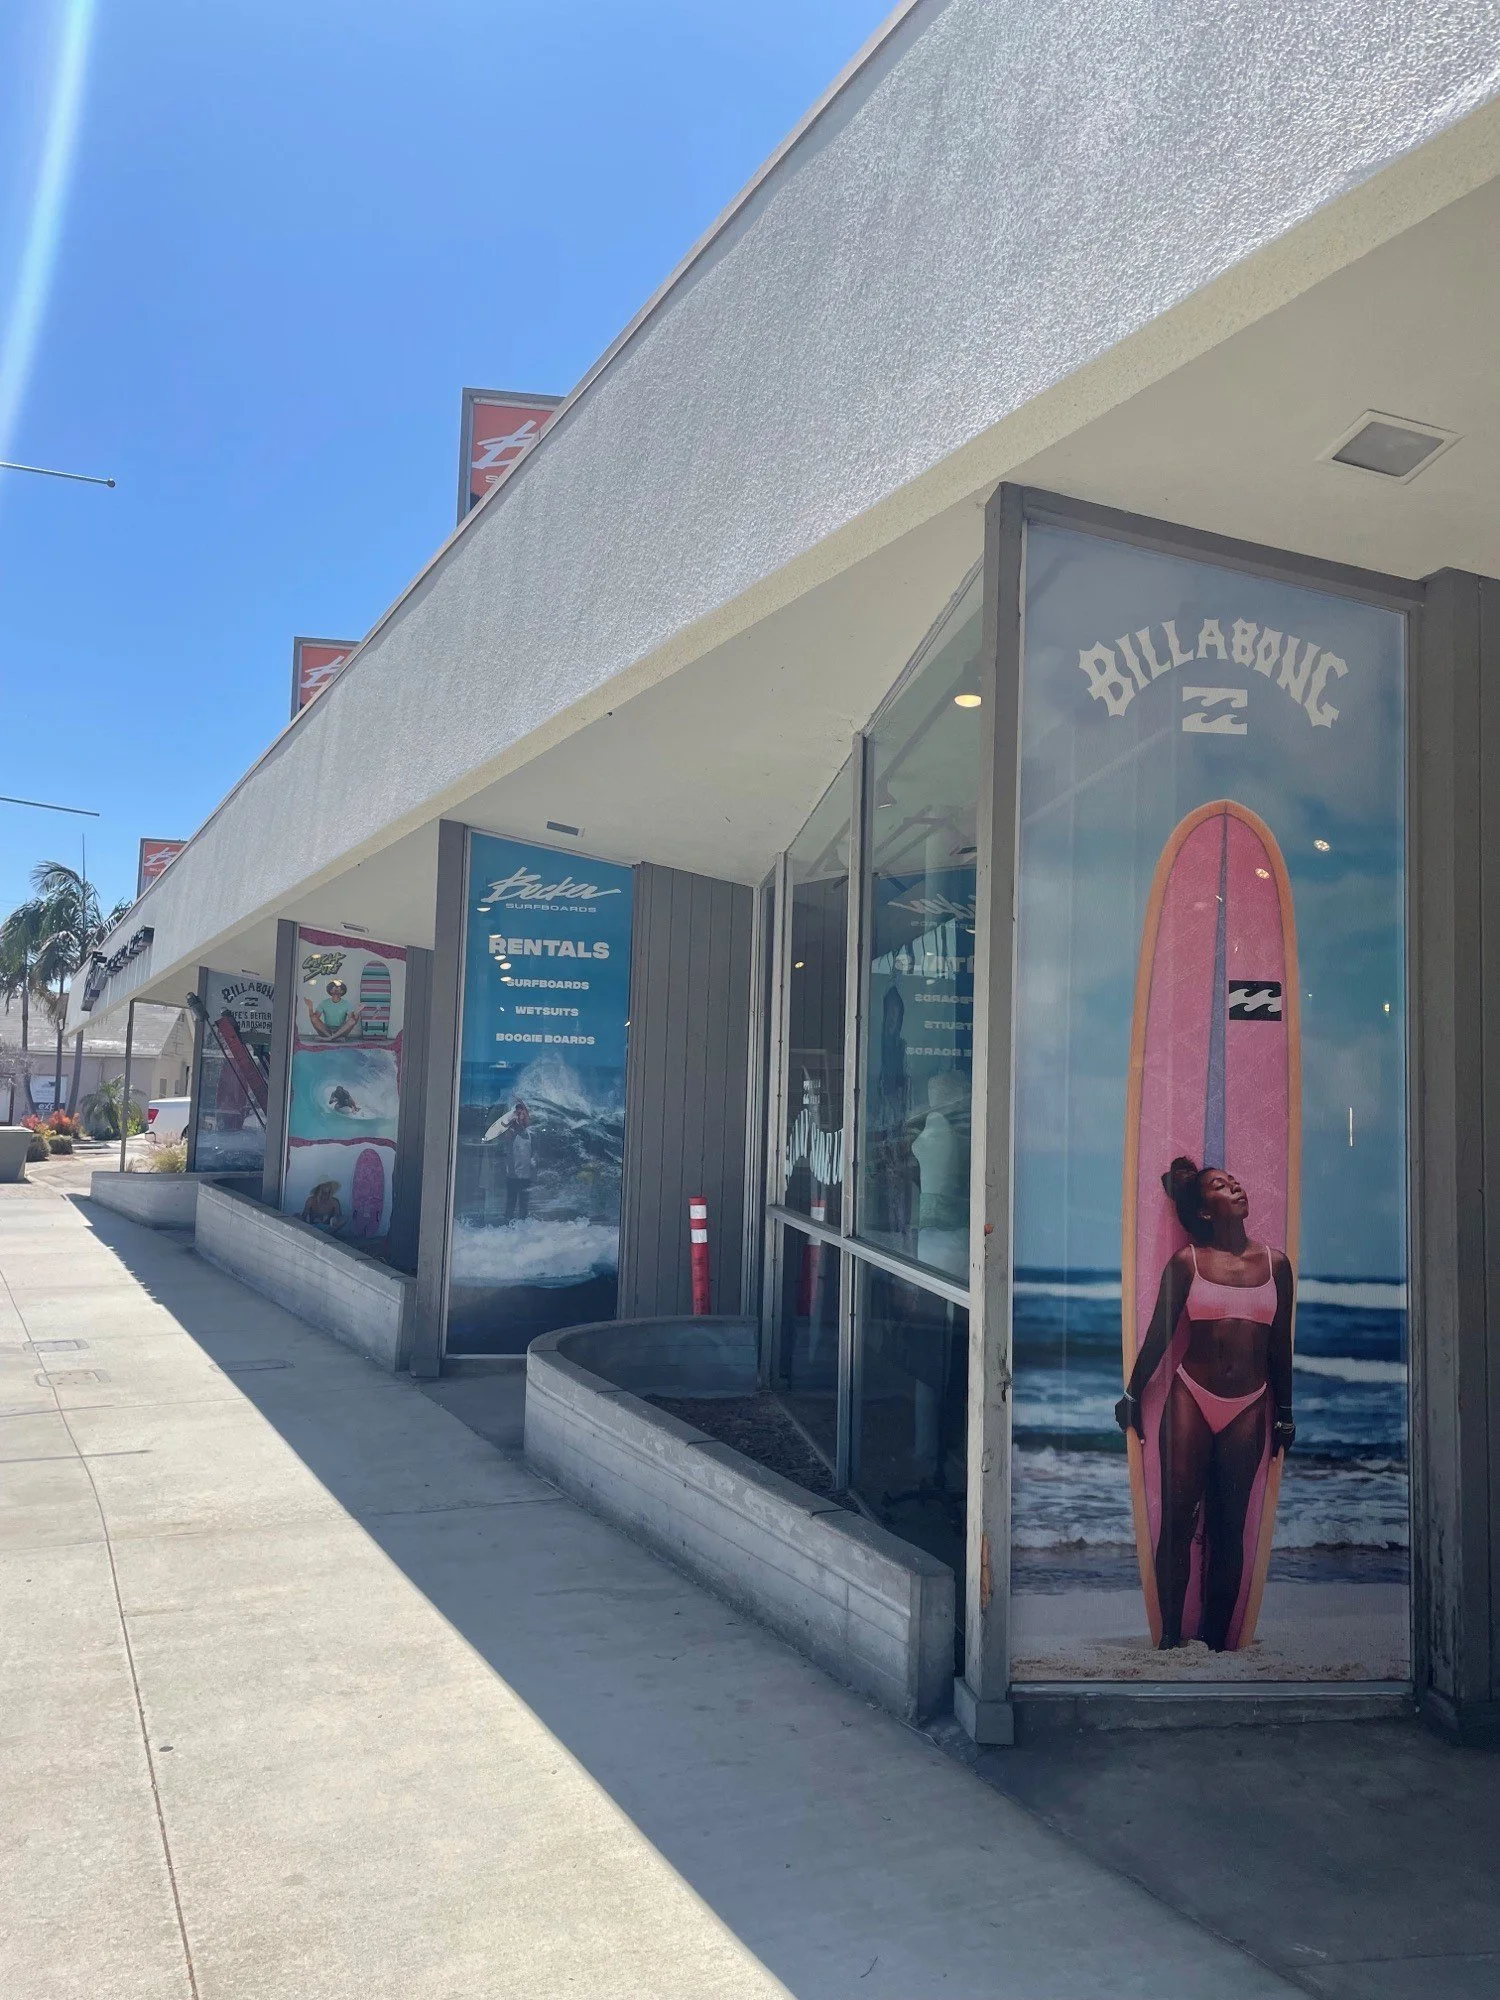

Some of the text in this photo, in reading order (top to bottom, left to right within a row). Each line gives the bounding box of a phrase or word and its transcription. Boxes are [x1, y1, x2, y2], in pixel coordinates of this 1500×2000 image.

[1078, 617, 1349, 728] BILLABONG
[480, 867, 622, 903] Becker
[505, 902, 597, 913] SURFBOARDS
[488, 937, 610, 959] RENTALS
[506, 978, 590, 990] SURFBOARDS
[221, 982, 275, 1003] BILLABON
[515, 1005, 580, 1017] WETSUITS
[495, 1033, 596, 1045] BOOGIE BOARDS
